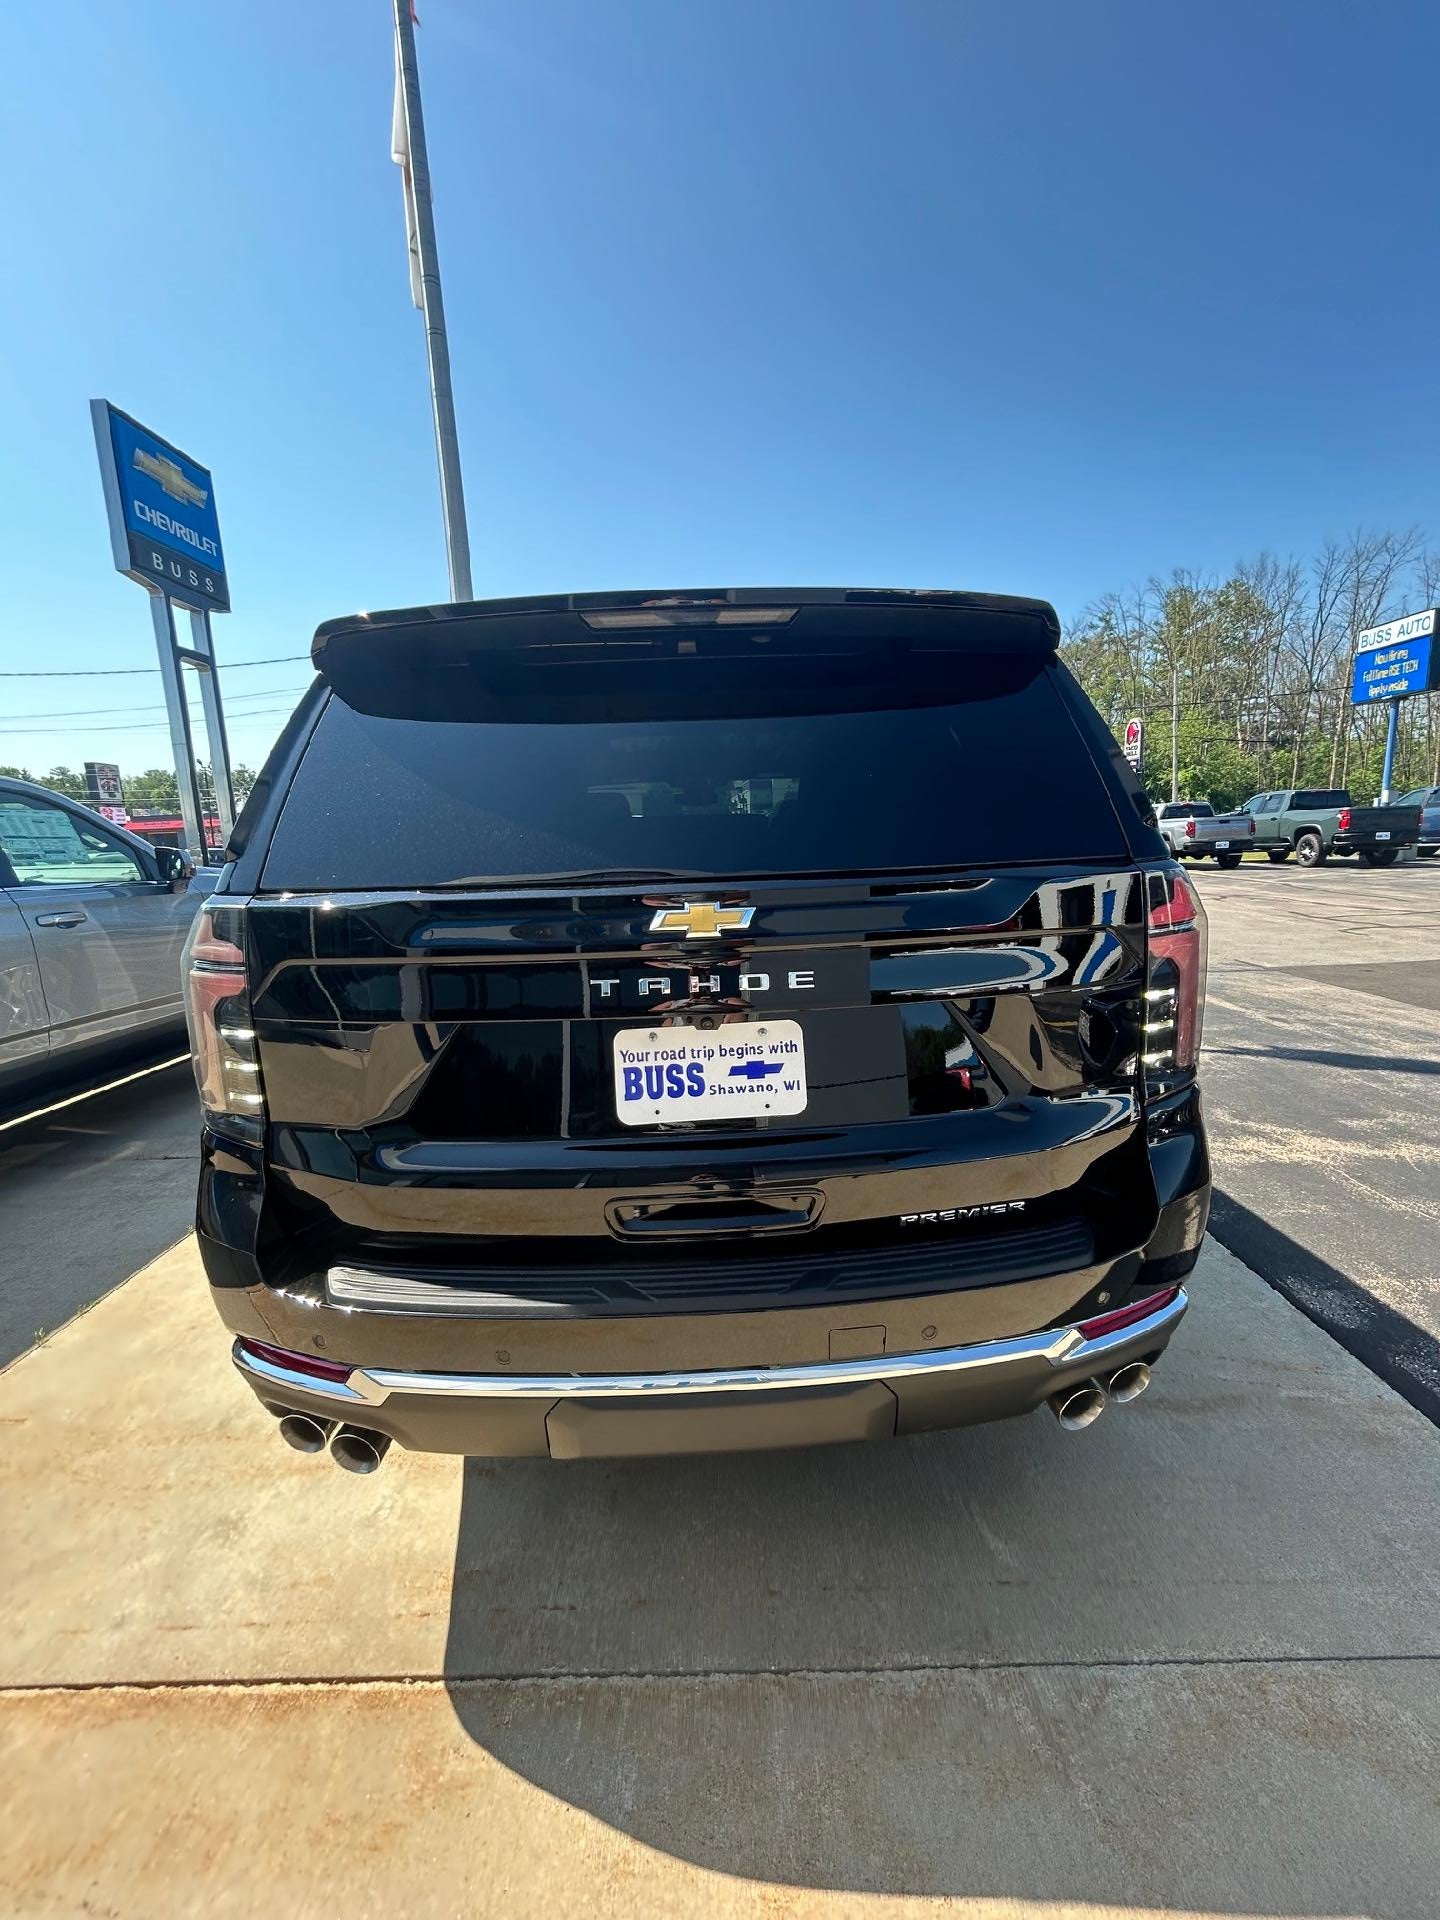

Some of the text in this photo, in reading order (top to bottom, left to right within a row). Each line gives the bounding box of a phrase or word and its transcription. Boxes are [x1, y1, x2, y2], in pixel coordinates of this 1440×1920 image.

[134, 500, 217, 556] CHEVROLET
[152, 552, 214, 592] BUSS
[1361, 616, 1430, 648] BUSS AUTO
[590, 971, 815, 997] TAHOE
[620, 1040, 798, 1063] Your road trip begins with
[623, 1062, 706, 1101] BUSS
[709, 1080, 801, 1096] Shawano, WI
[900, 1201, 1026, 1225] PREMIER
